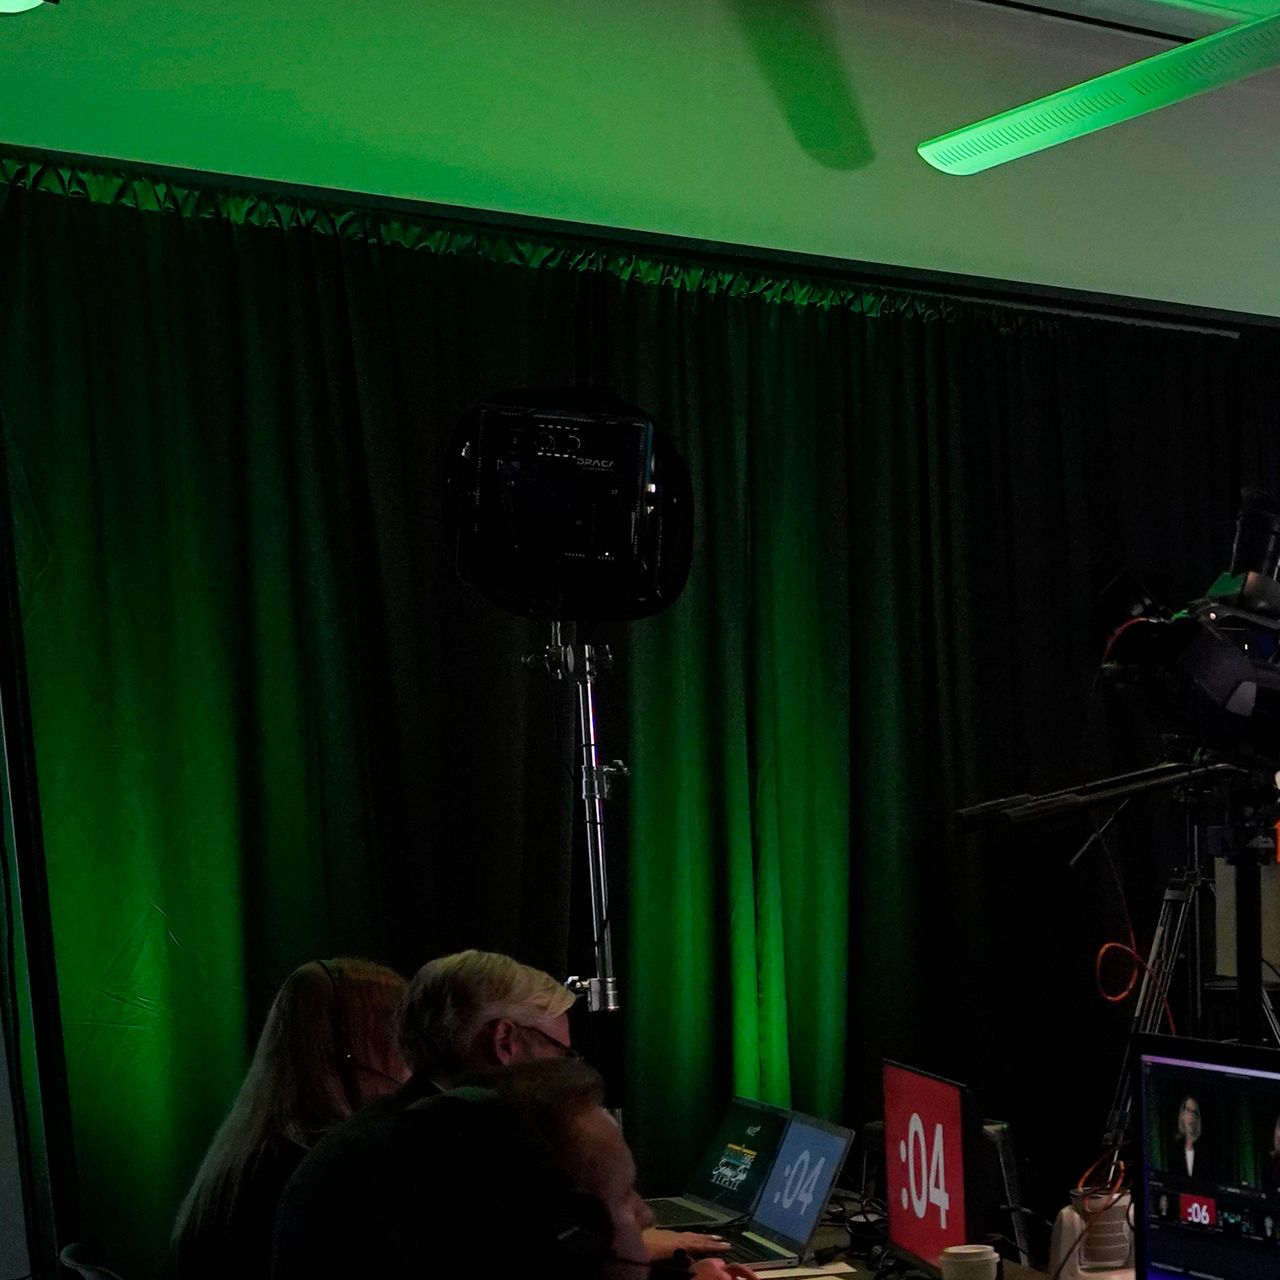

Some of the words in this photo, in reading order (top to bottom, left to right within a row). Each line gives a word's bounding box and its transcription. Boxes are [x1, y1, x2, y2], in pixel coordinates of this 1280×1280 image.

[773, 1150, 826, 1216] :04
[900, 1112, 949, 1230] :04
[1187, 1202, 1209, 1225] :06
